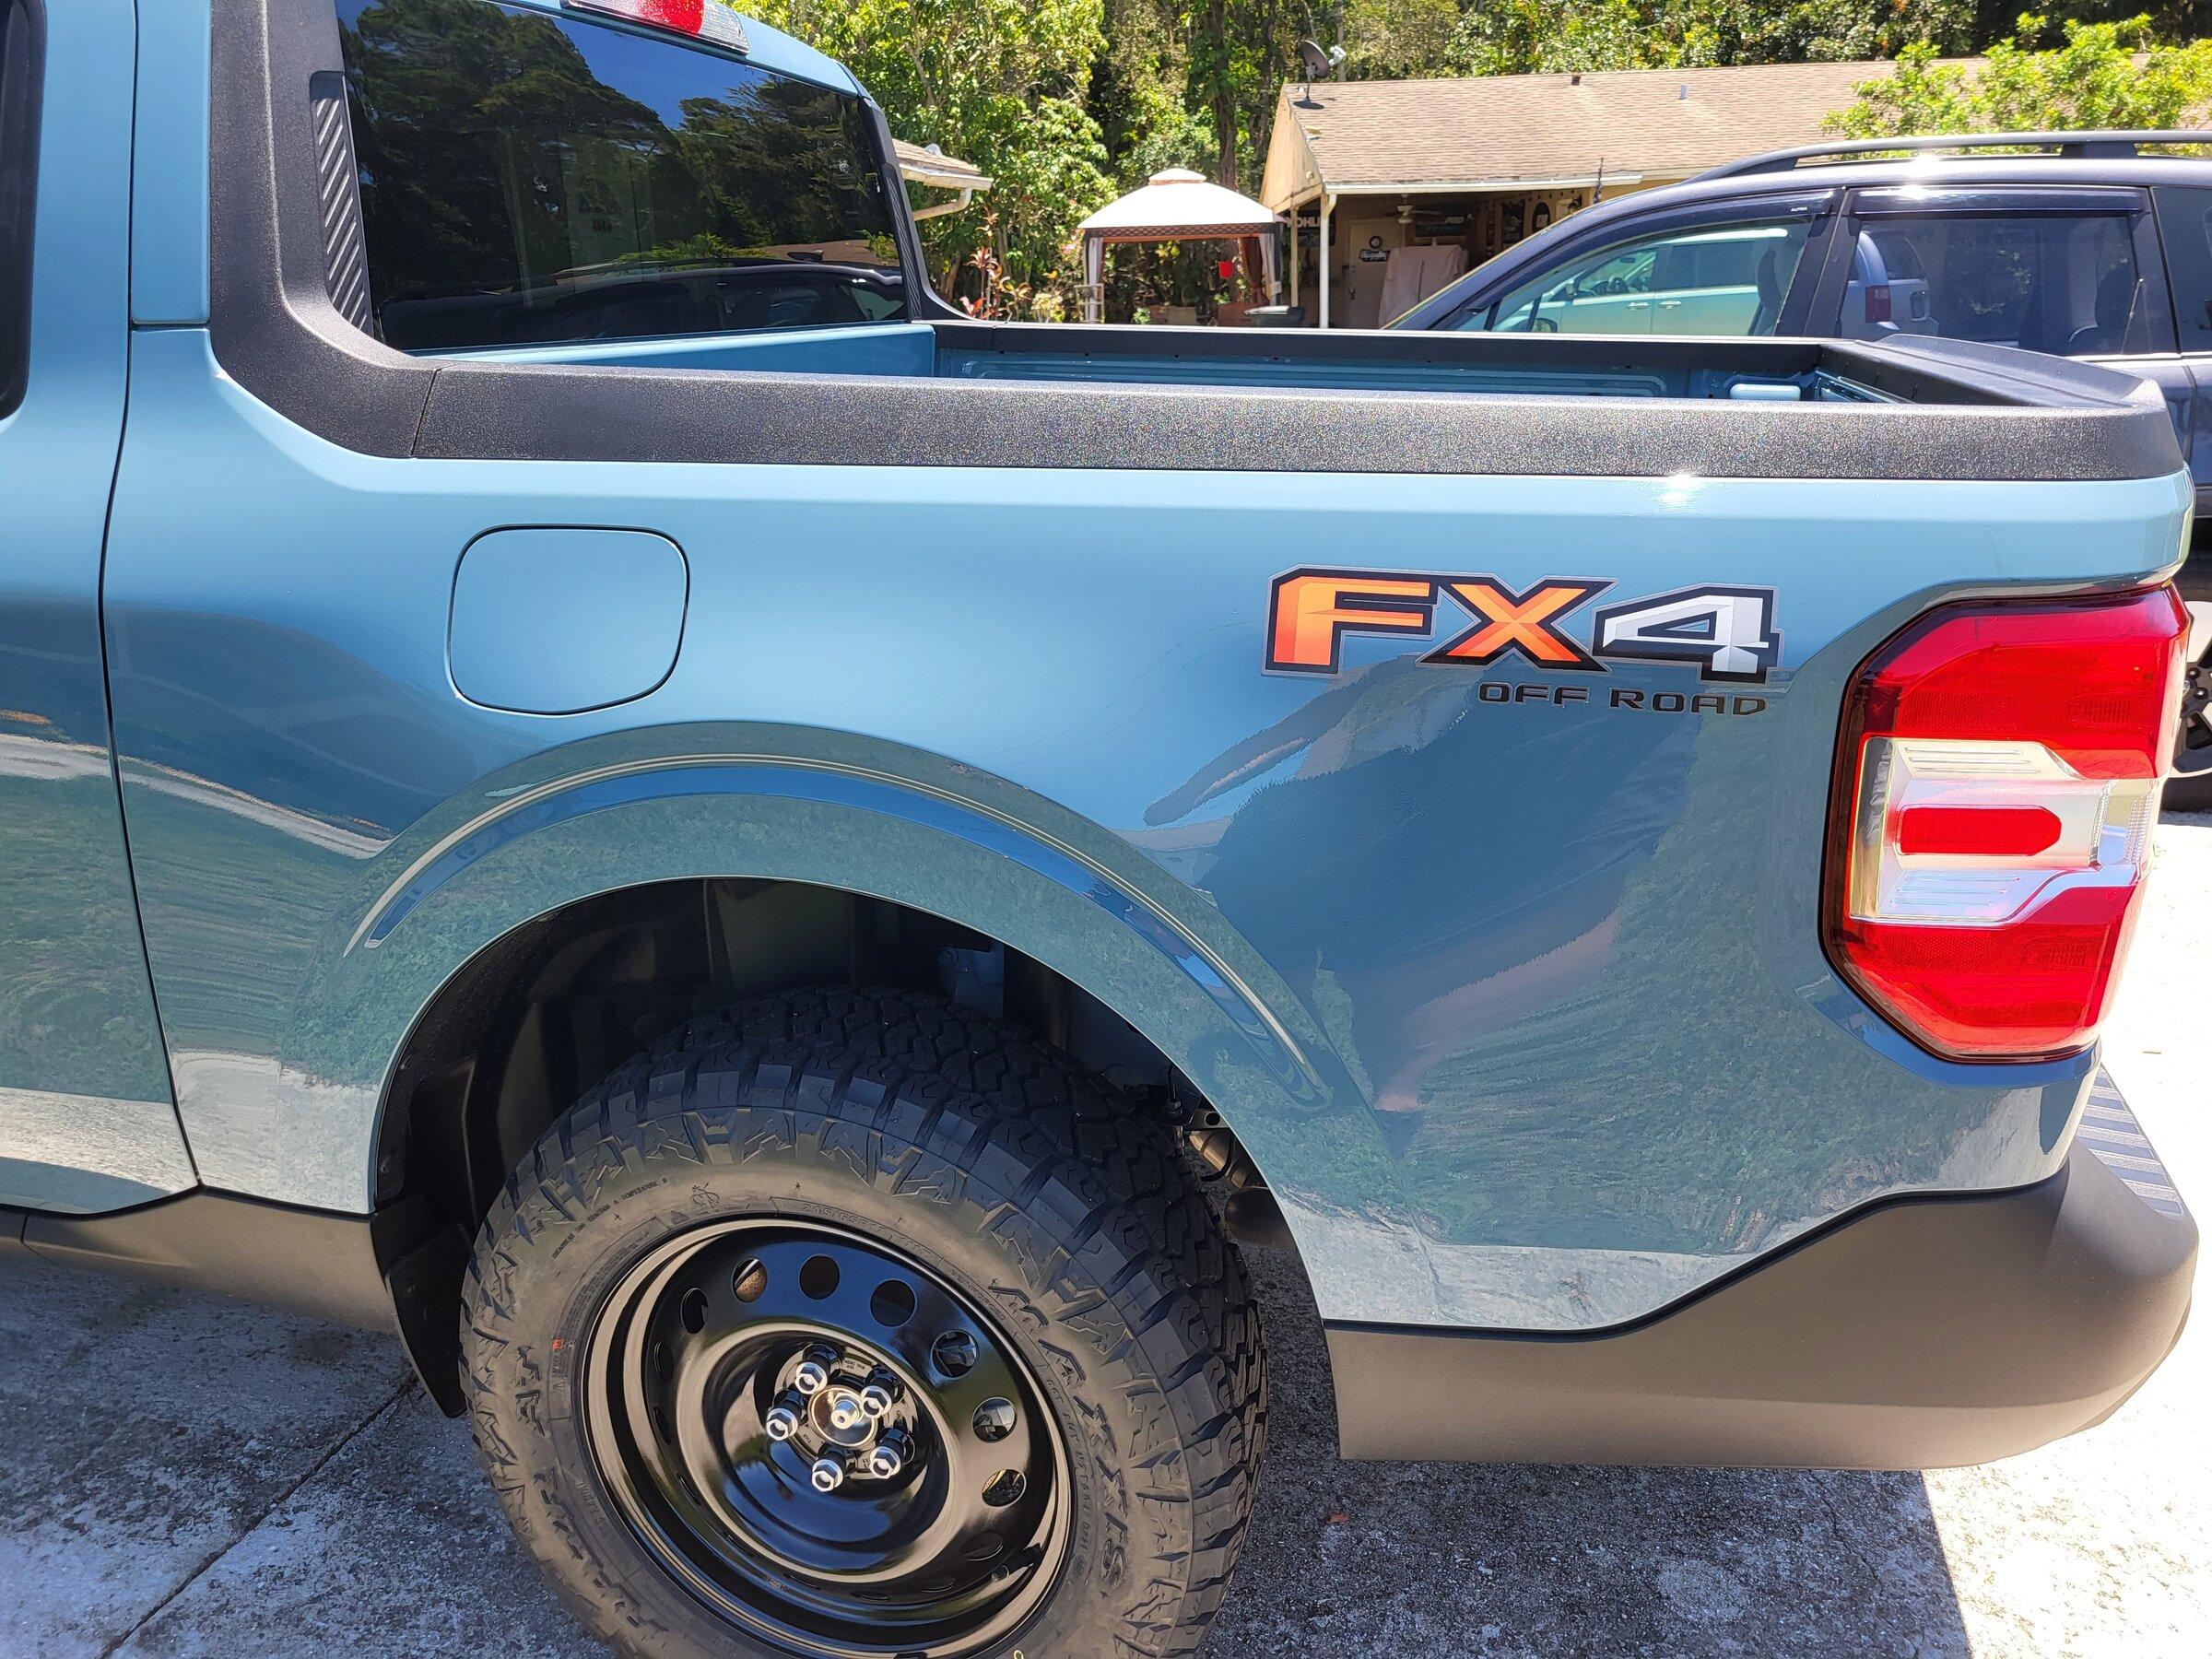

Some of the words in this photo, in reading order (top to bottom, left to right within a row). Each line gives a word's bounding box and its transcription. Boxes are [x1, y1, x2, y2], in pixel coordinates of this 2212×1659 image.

[1262, 564, 1782, 684] FX4
[1479, 681, 1590, 706] OFF
[1609, 688, 1769, 715] ROAD
[620, 1181, 658, 1200] TEMPERATURE
[987, 1285, 1126, 1590] MAXXIS
